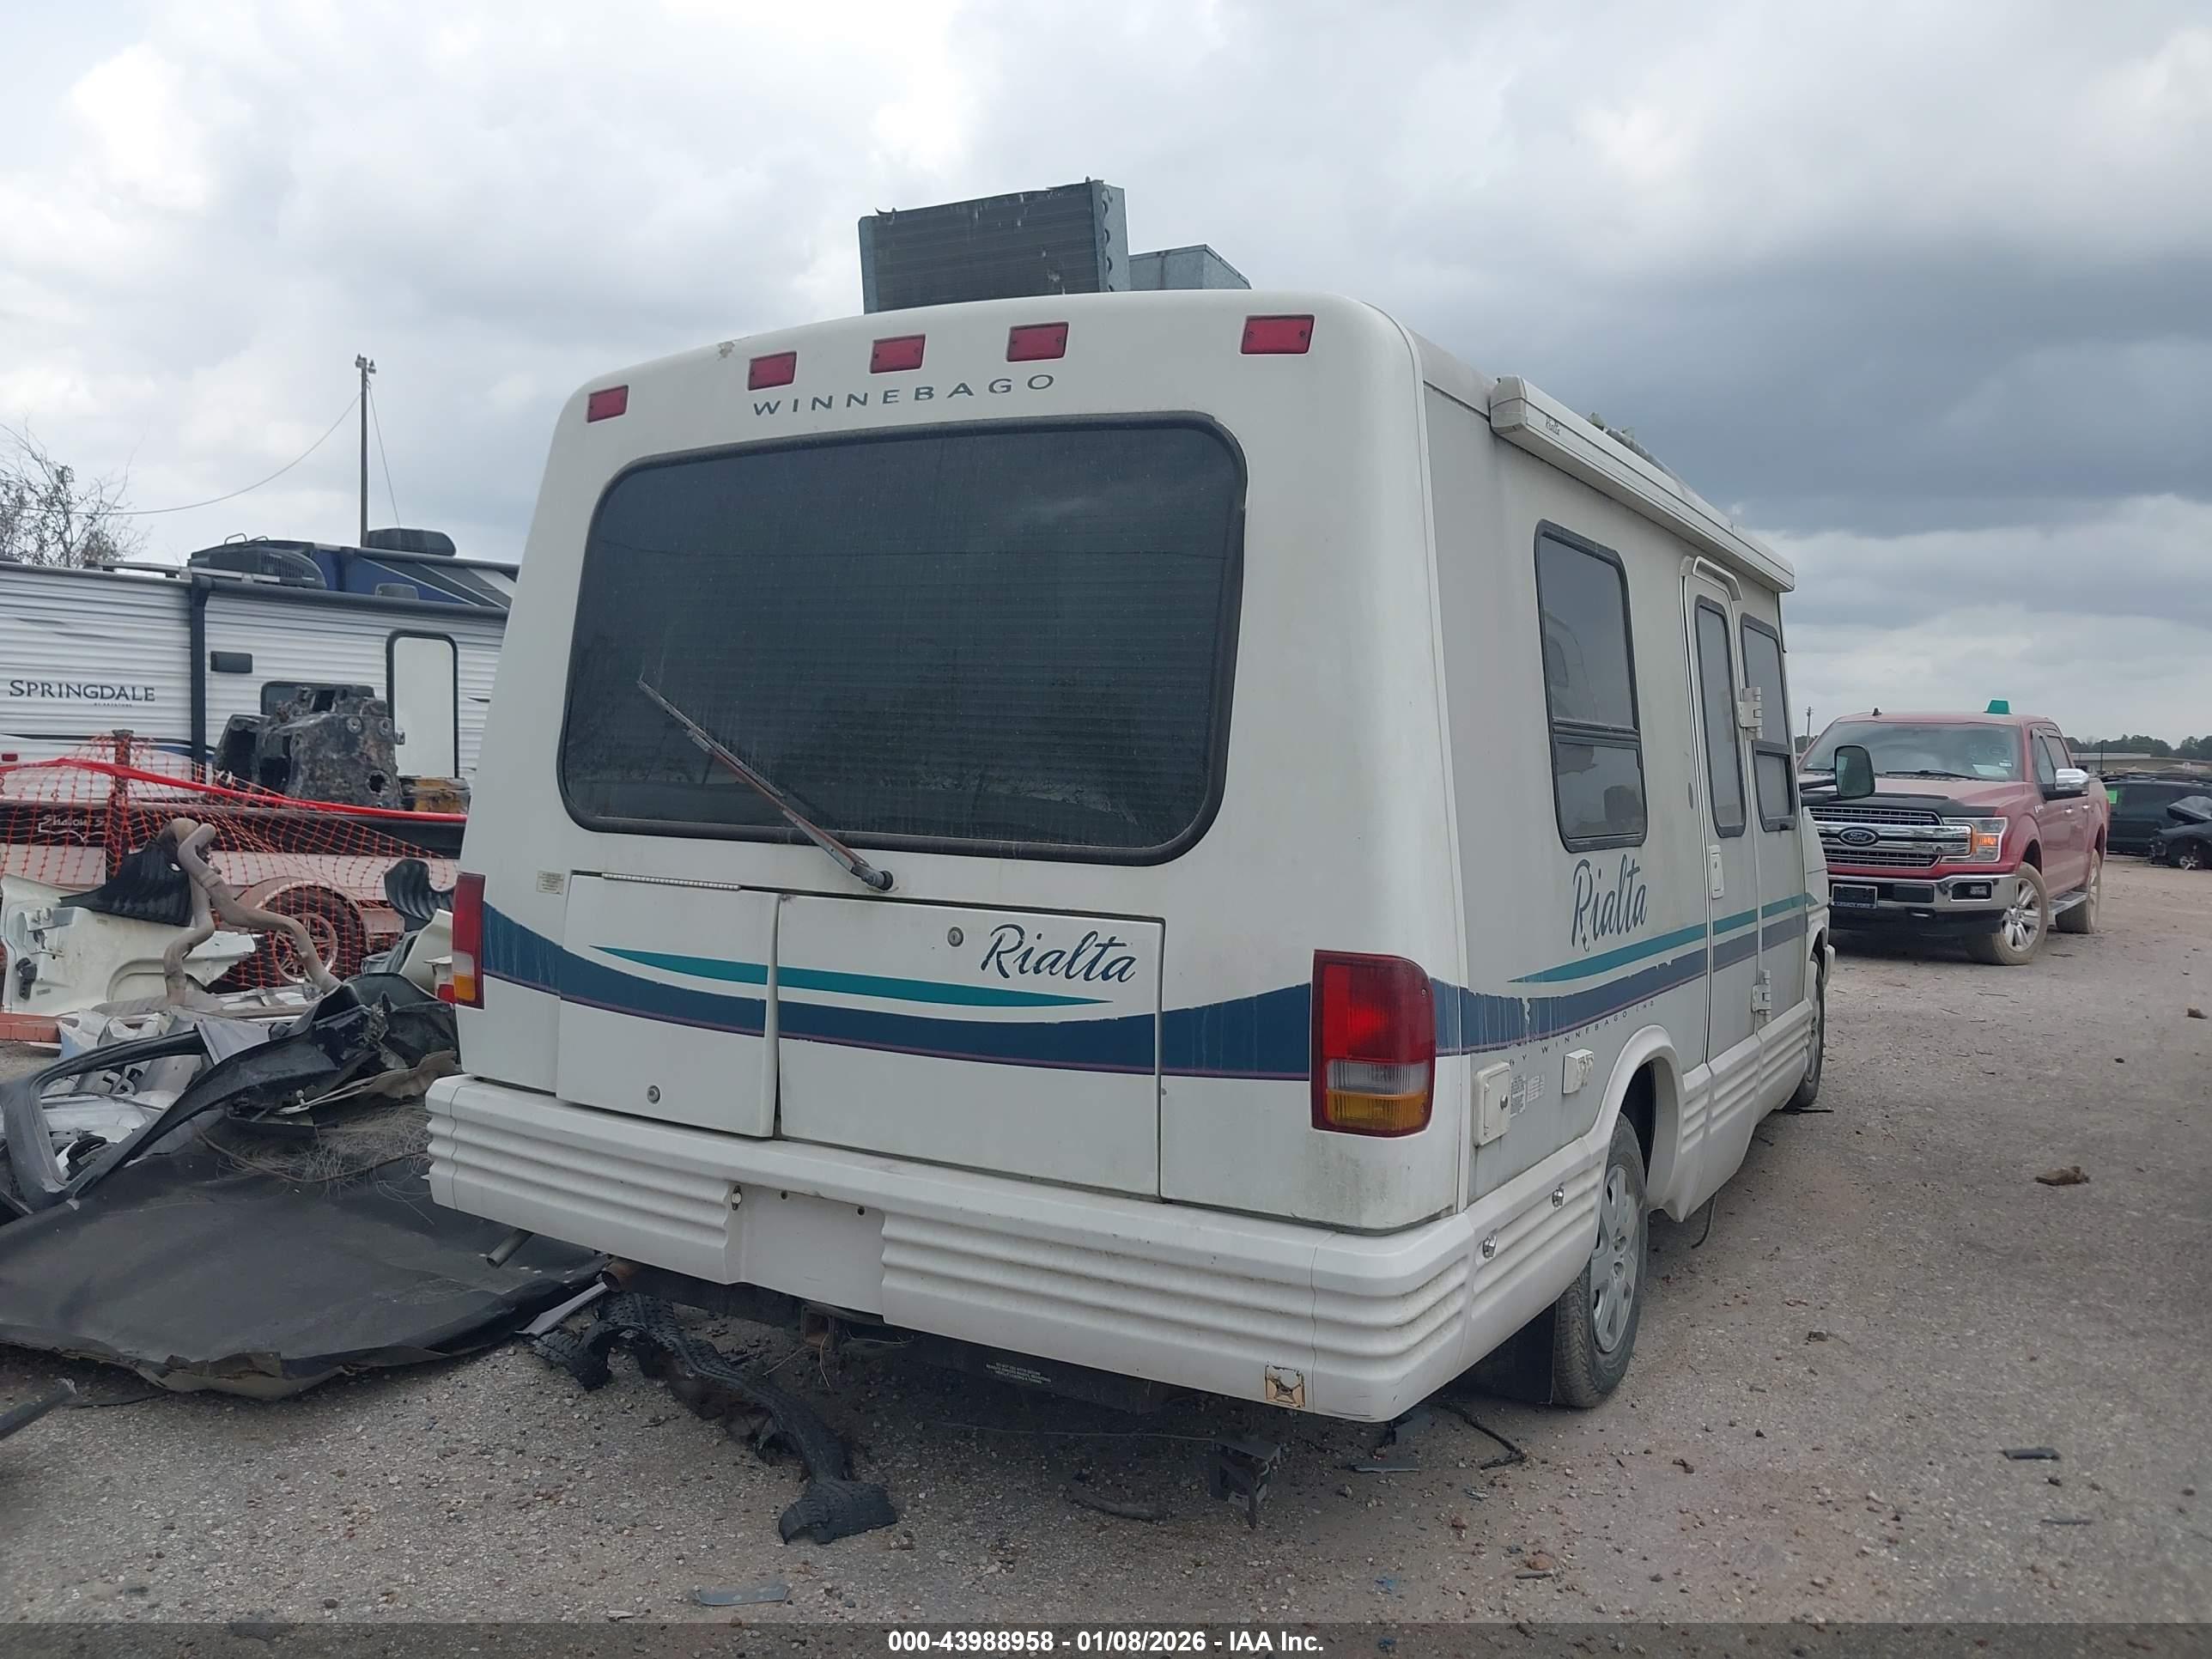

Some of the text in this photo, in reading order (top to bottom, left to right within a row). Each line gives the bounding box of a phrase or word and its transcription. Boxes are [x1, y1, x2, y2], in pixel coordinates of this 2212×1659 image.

[754, 374, 1054, 416] WINNEBAGO
[1571, 854, 1648, 952] Rialta
[981, 924, 1137, 982] Rialta
[1541, 1011, 1627, 1055] WINNEBAGO
